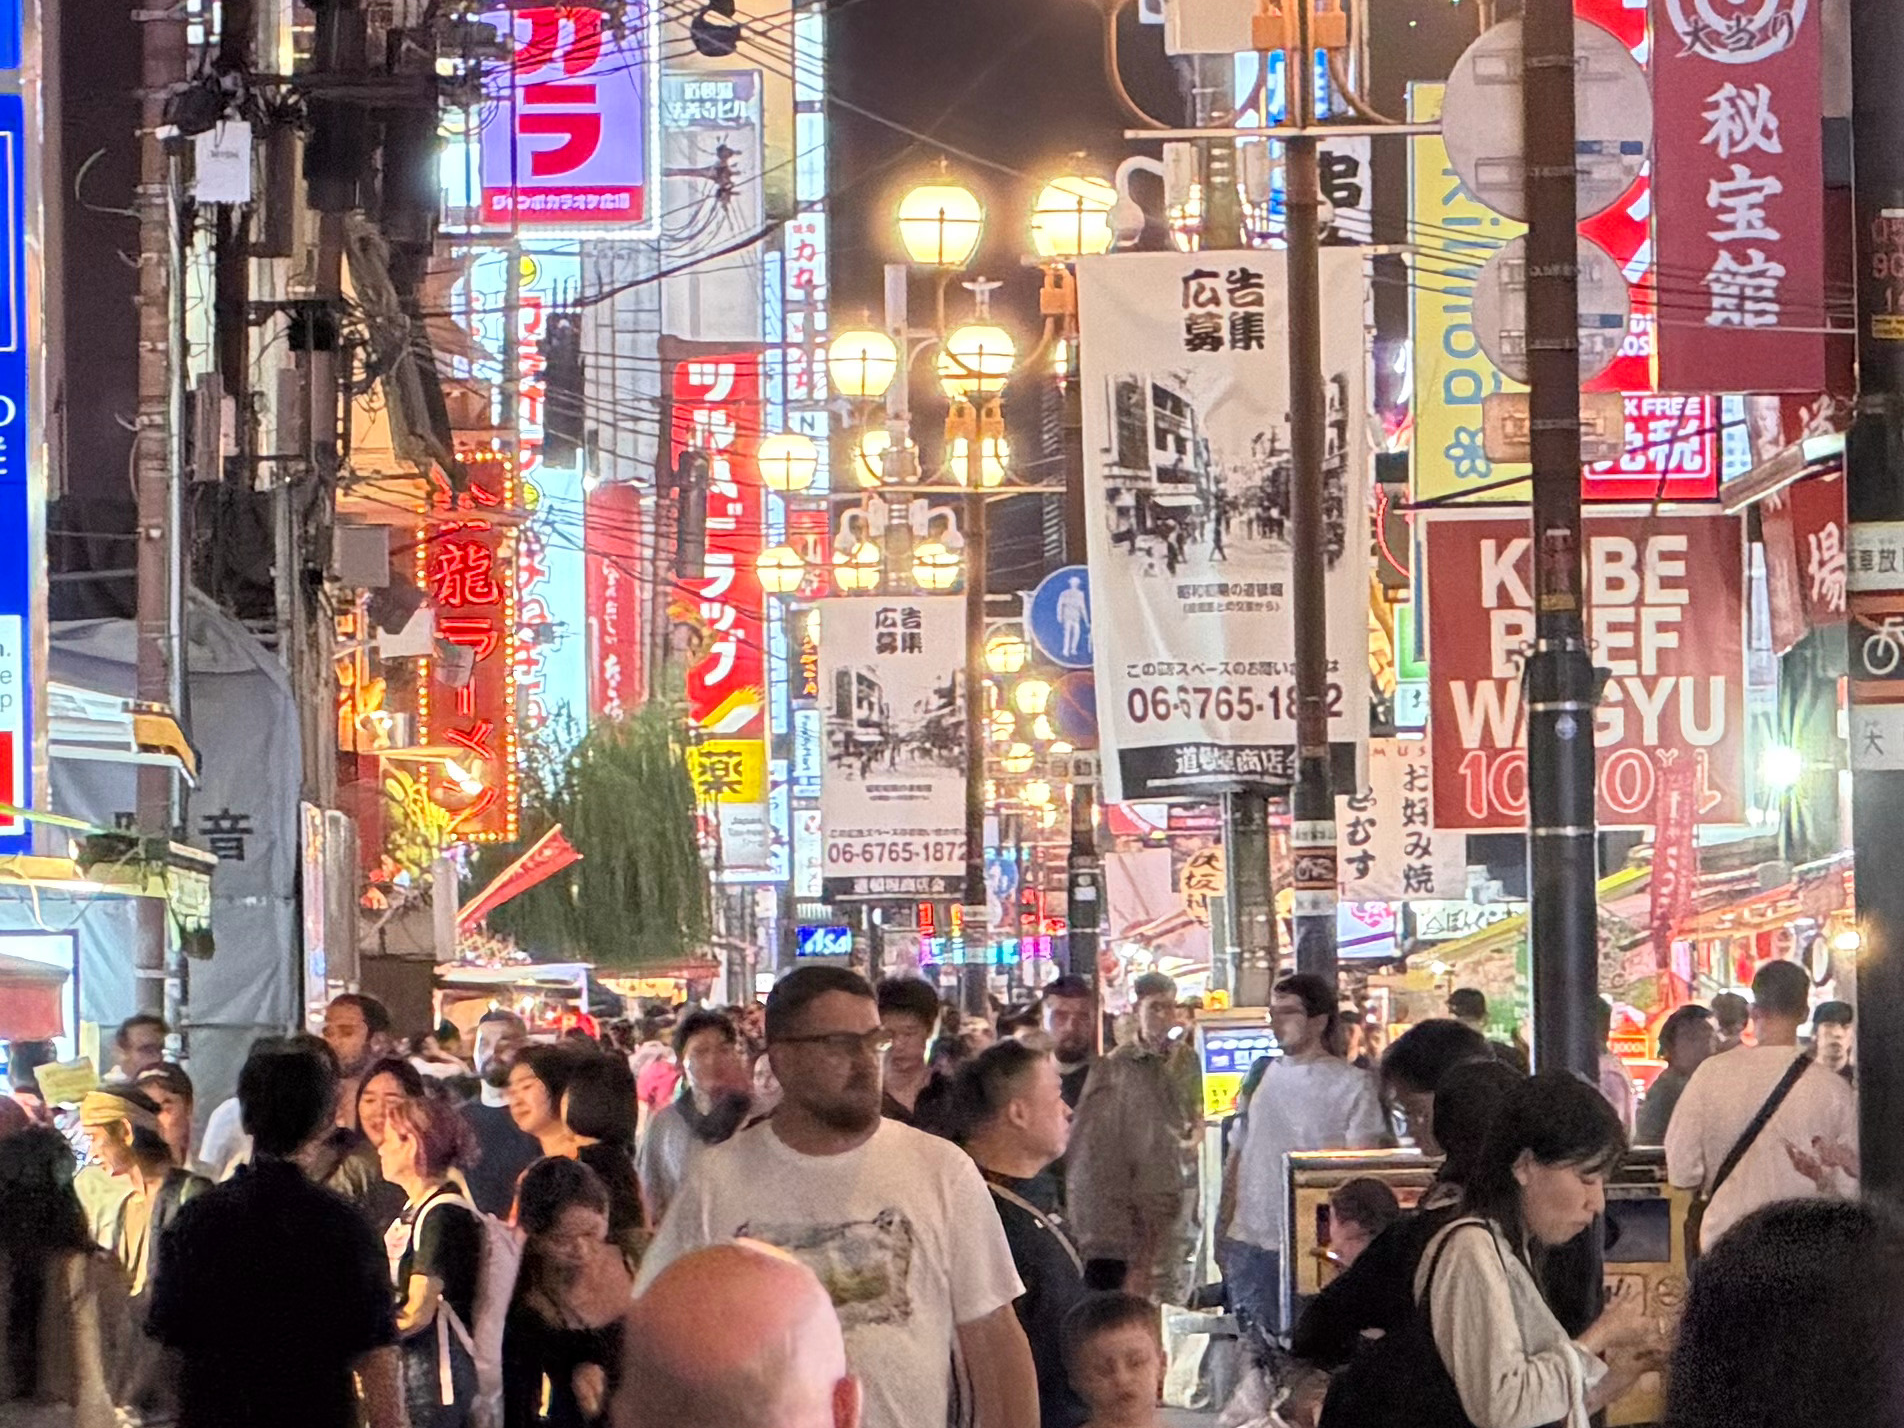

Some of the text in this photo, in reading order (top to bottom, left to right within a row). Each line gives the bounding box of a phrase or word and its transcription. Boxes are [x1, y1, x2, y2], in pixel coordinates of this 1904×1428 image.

[1700, 82, 1787, 330] 秘宝館
[1181, 267, 1265, 309] 広告
[1182, 310, 1265, 353] 募集
[1641, 396, 1701, 416] FREE
[1480, 534, 1691, 608] KBE
[1489, 605, 1684, 679] BEF
[1127, 682, 1344, 724] 06-6765-182
[1448, 676, 1727, 749] WGYU
[1401, 763, 1435, 895] お好み焼
